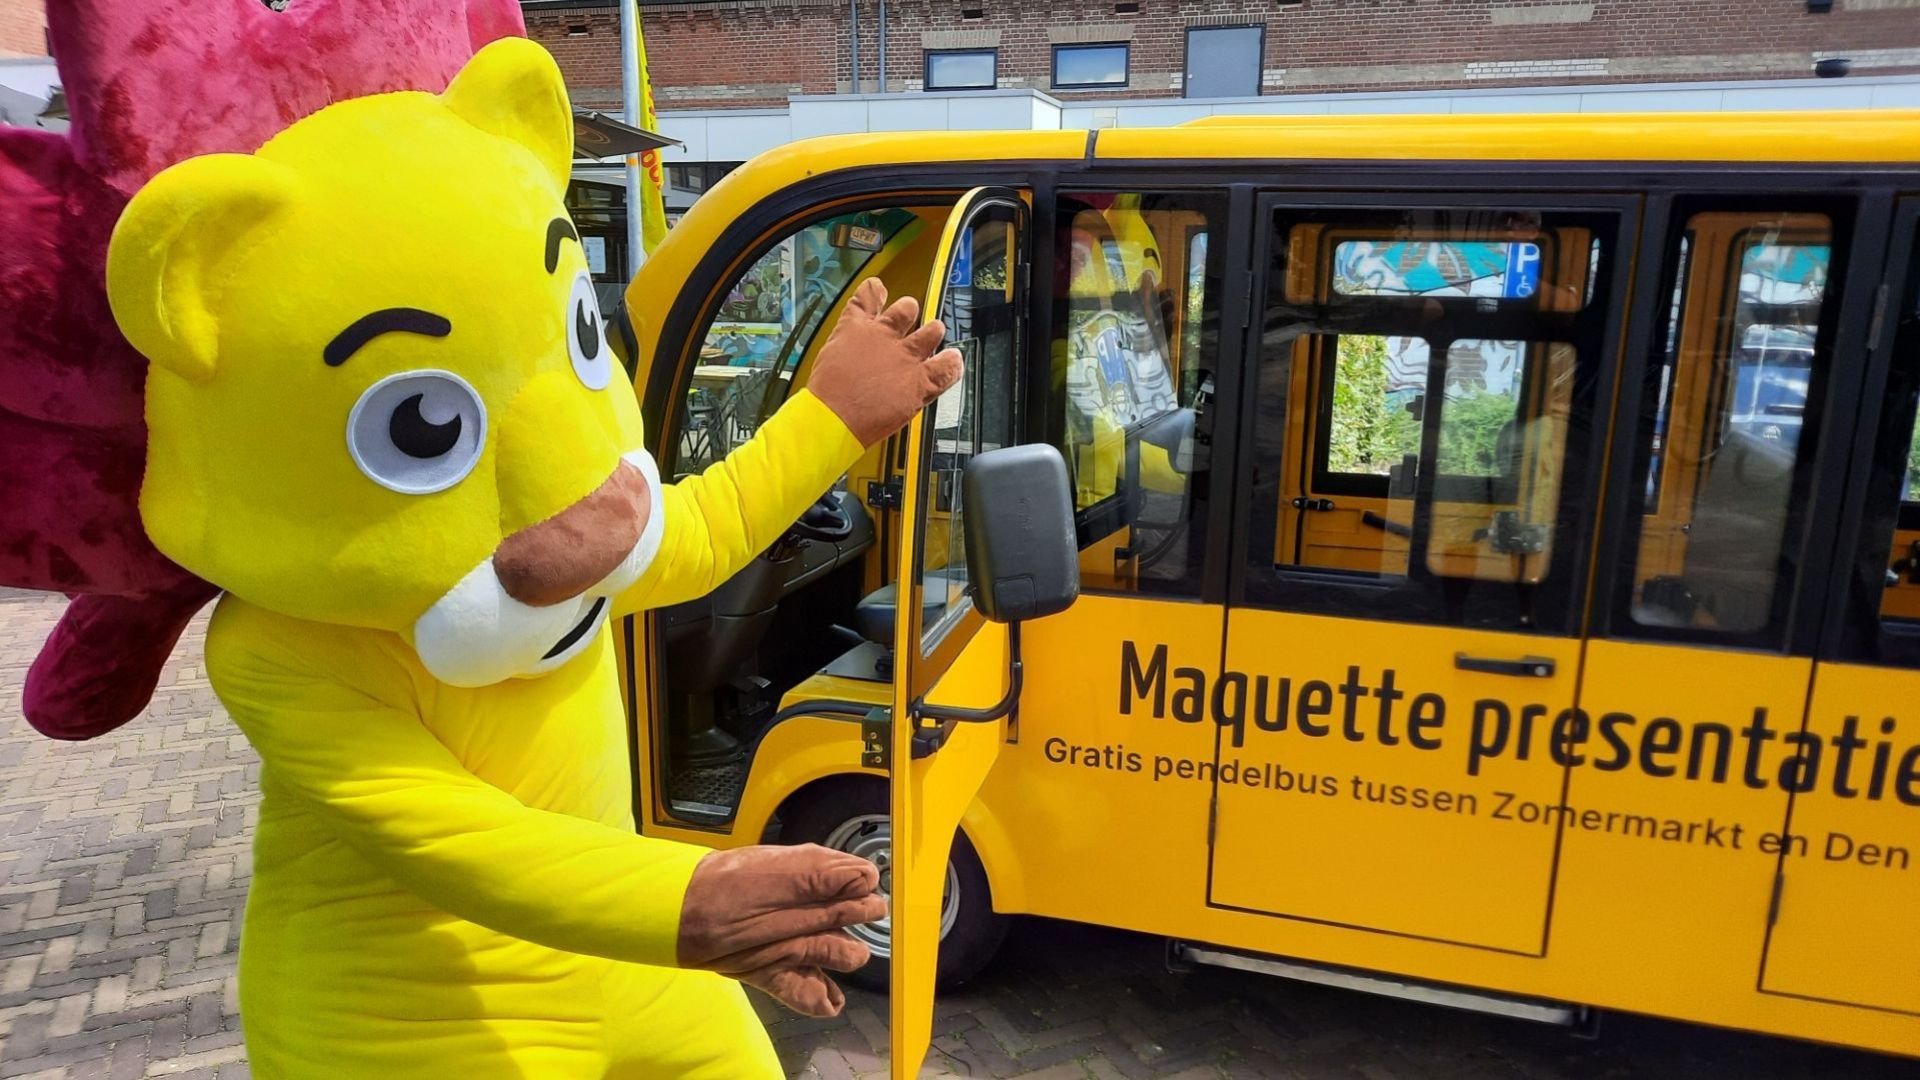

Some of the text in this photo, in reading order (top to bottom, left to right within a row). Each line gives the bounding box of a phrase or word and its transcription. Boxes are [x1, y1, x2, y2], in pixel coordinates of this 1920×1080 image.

[1517, 243, 1540, 273] P
[1119, 640, 1920, 807] Maquette presentatie
[1044, 737, 1910, 870] Gratis pendelbus tussen Zomermarkt en Den
